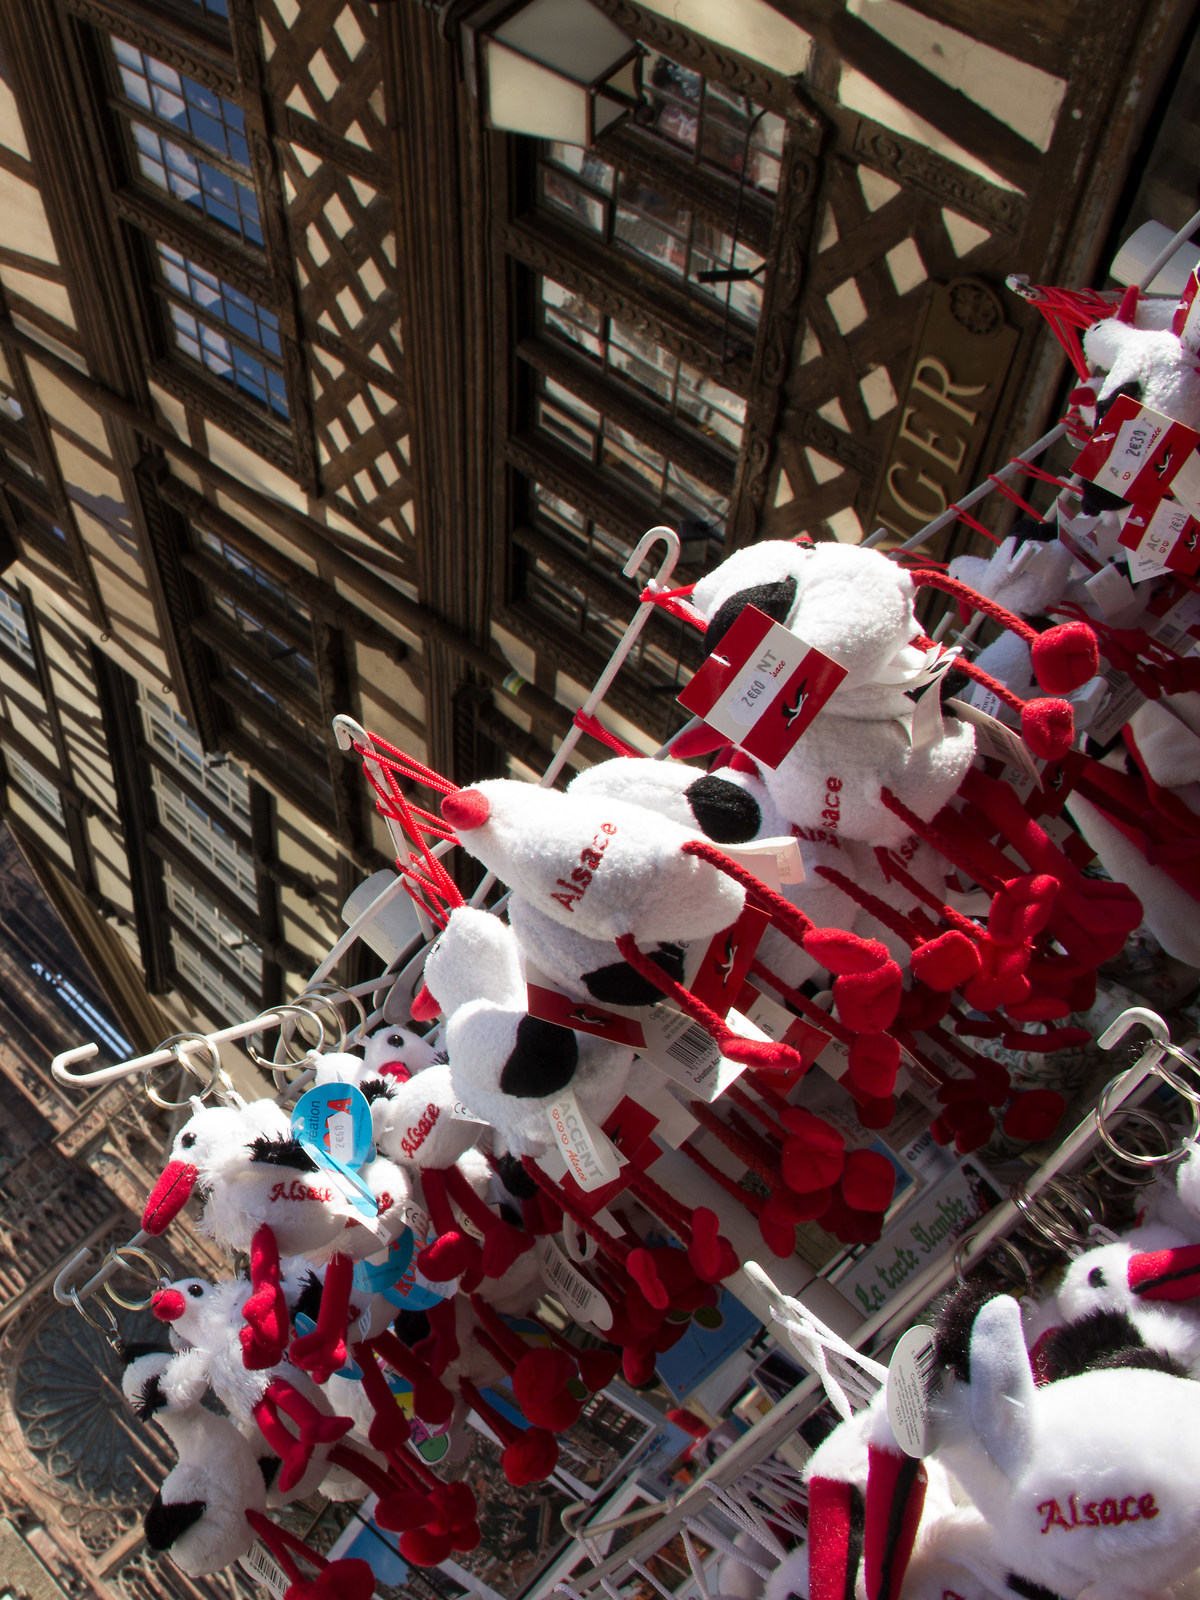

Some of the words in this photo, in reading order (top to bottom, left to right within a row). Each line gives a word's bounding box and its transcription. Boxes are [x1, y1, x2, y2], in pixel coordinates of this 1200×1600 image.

[741, 679, 766, 708] 2€60
[550, 822, 618, 913] Alsace
[401, 1103, 441, 1159] Alsace
[560, 1102, 603, 1177] ACCENT
[268, 1179, 335, 1203] Alsace
[855, 1282, 887, 1313] La
[874, 1245, 920, 1290] tarte
[1036, 1492, 1159, 1534] Alsace
